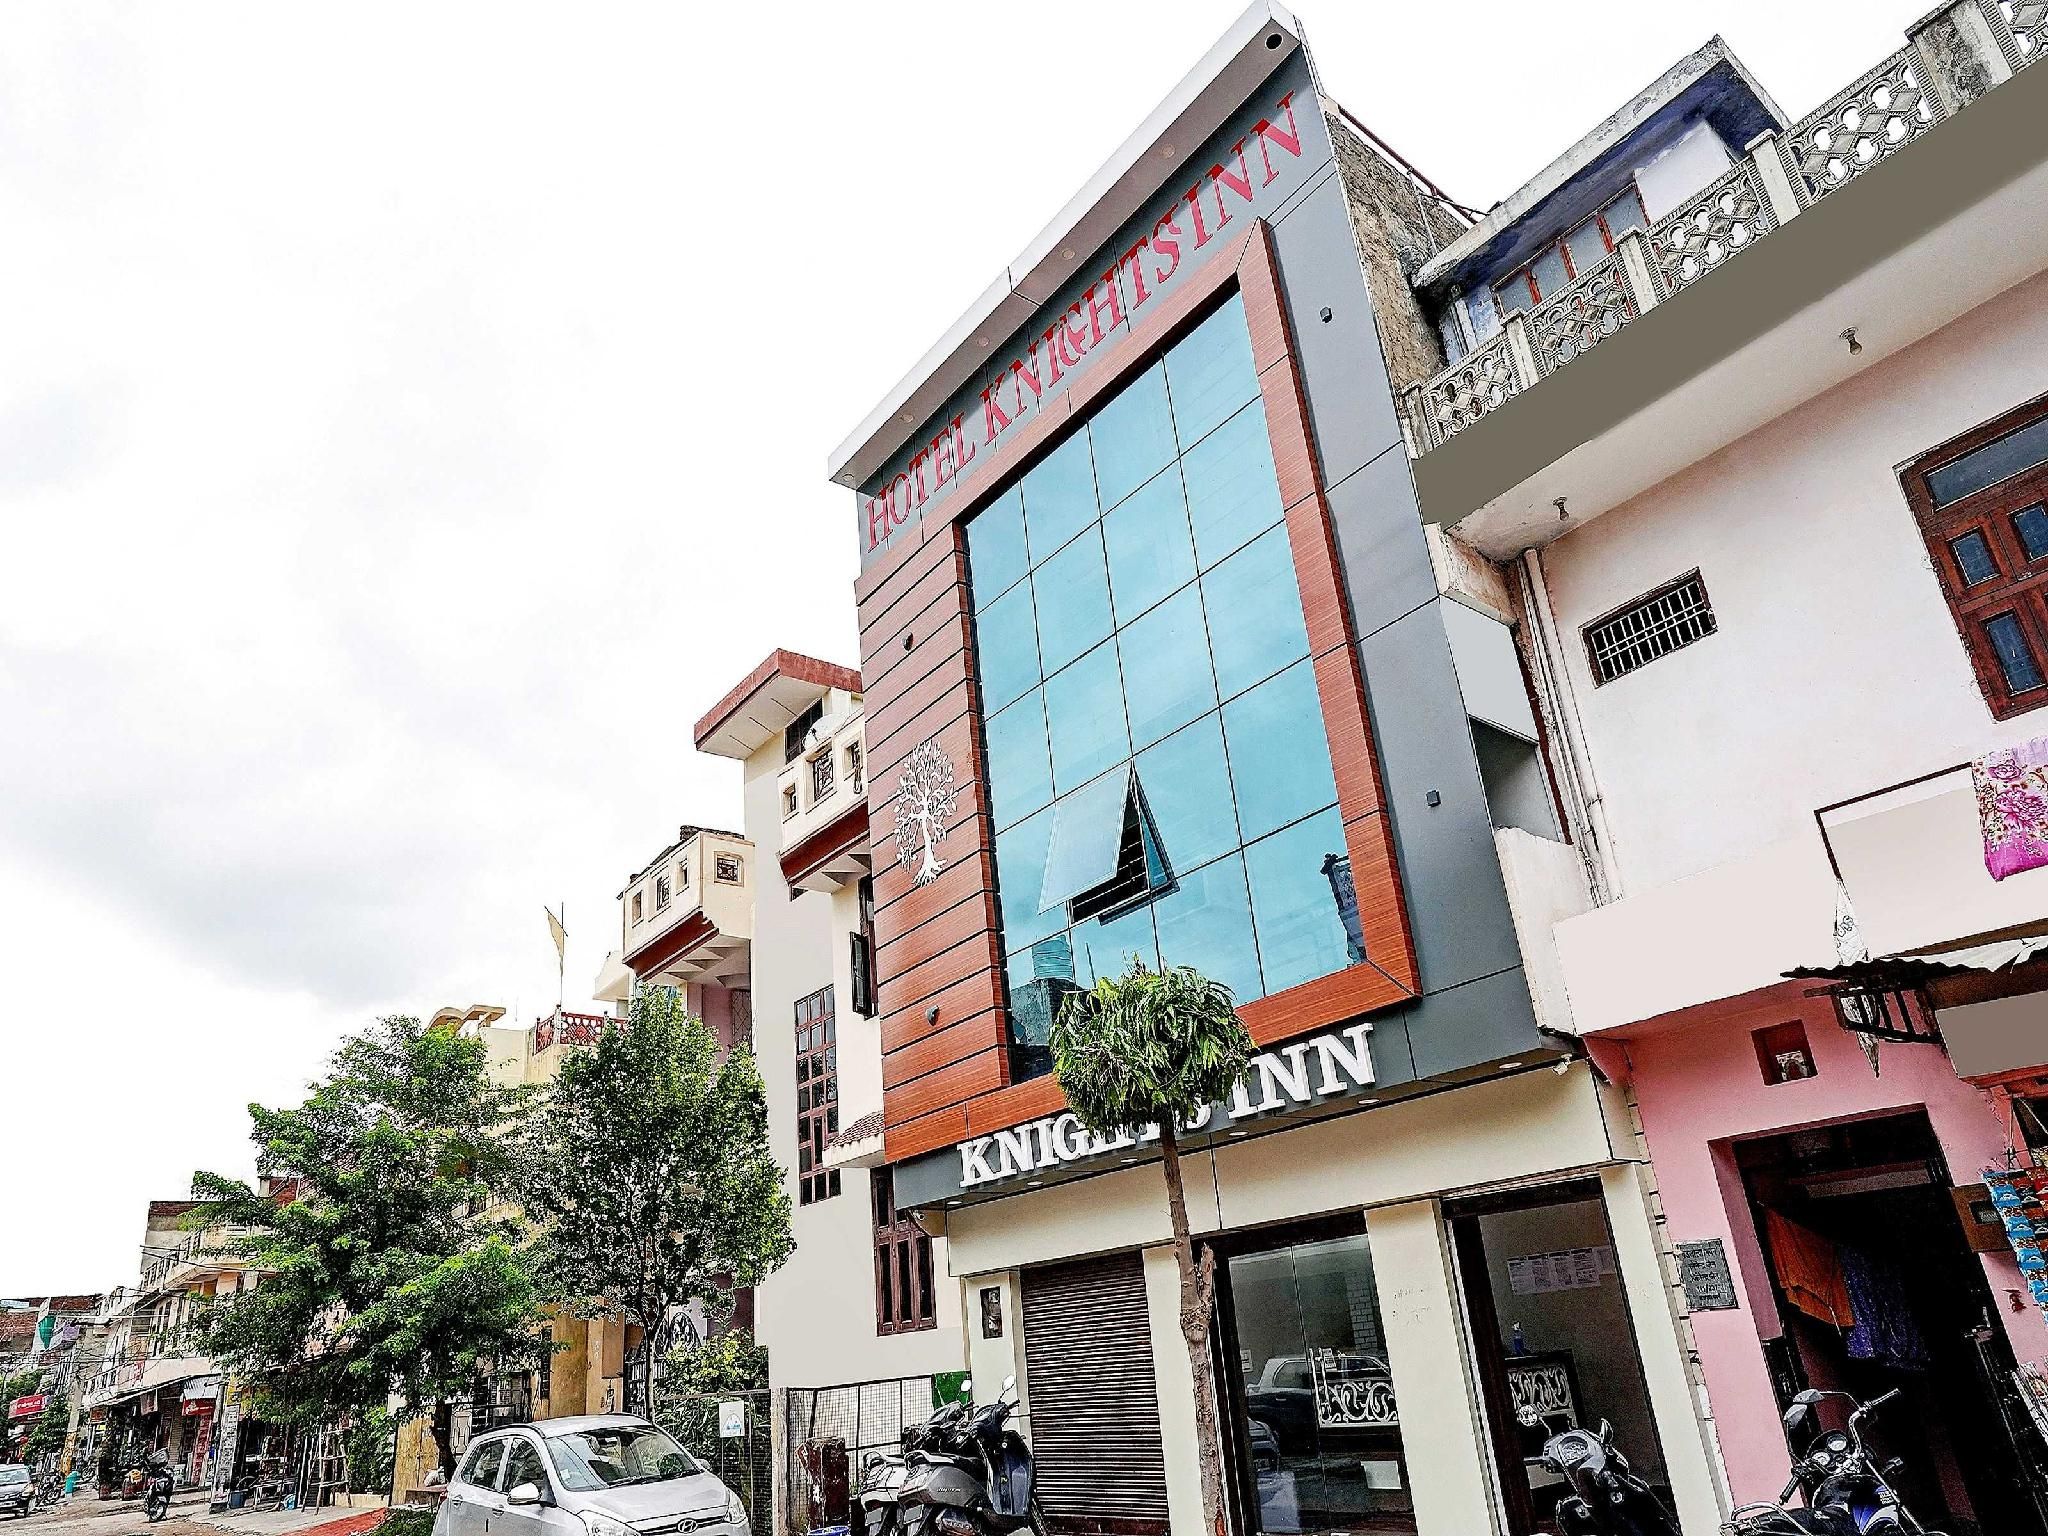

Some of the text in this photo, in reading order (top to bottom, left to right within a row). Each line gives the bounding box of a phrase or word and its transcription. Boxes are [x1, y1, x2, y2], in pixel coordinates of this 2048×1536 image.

[865, 409, 976, 553] HOTEL
[1182, 89, 1303, 251] INN
[1228, 1022, 1375, 1120] INN
